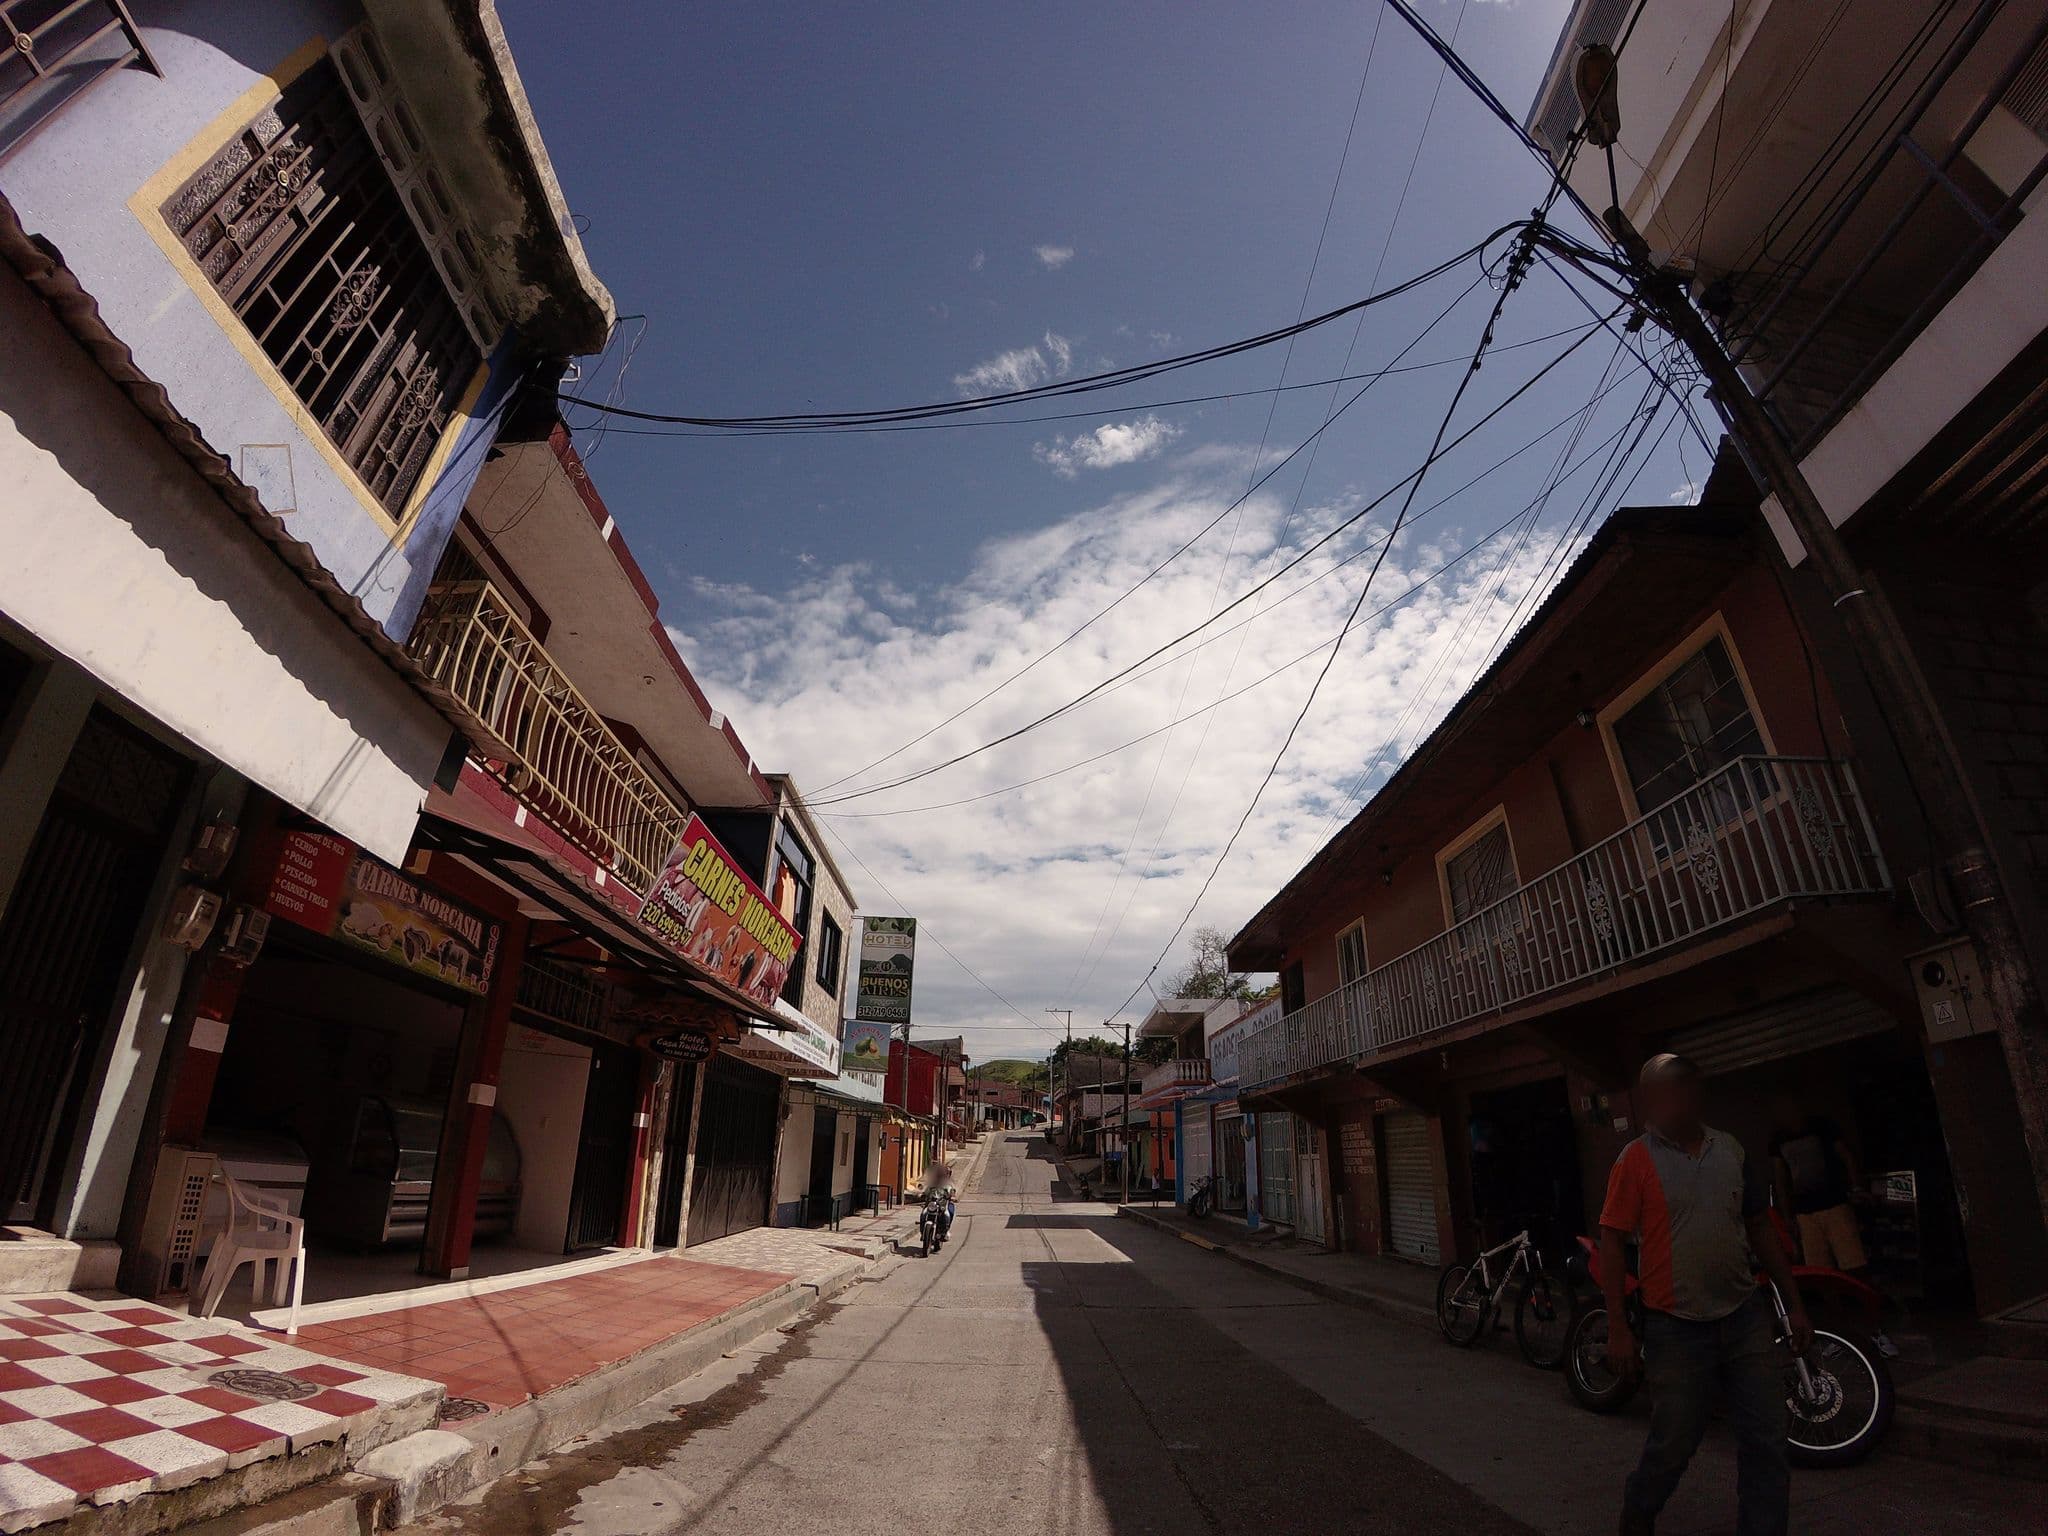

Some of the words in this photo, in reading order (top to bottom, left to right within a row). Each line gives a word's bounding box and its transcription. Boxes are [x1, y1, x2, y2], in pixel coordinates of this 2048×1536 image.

[294, 837, 319, 857] CERDO
[332, 842, 346, 857] RES
[289, 850, 313, 870] POLLO
[284, 865, 318, 888] PESCADO
[280, 879, 308, 900] CARNES
[308, 891, 329, 909] FRIAS
[683, 838, 746, 918] CARNES
[738, 893, 795, 966] NORCASIA
[356, 860, 418, 906] CARNES
[420, 892, 484, 949] NORCASIA
[642, 901, 661, 924] 320
[657, 912, 675, 934] 699
[670, 923, 683, 940] 93
[864, 934, 912, 946] HOTEL
[478, 924, 501, 994] QUESO
[860, 985, 909, 997] AIRES
[861, 976, 909, 990] BUENOS
[858, 1005, 872, 1017] 312
[873, 1006, 886, 1017] 719
[887, 1007, 907, 1018] 0468
[679, 1032, 706, 1045] Hotel
